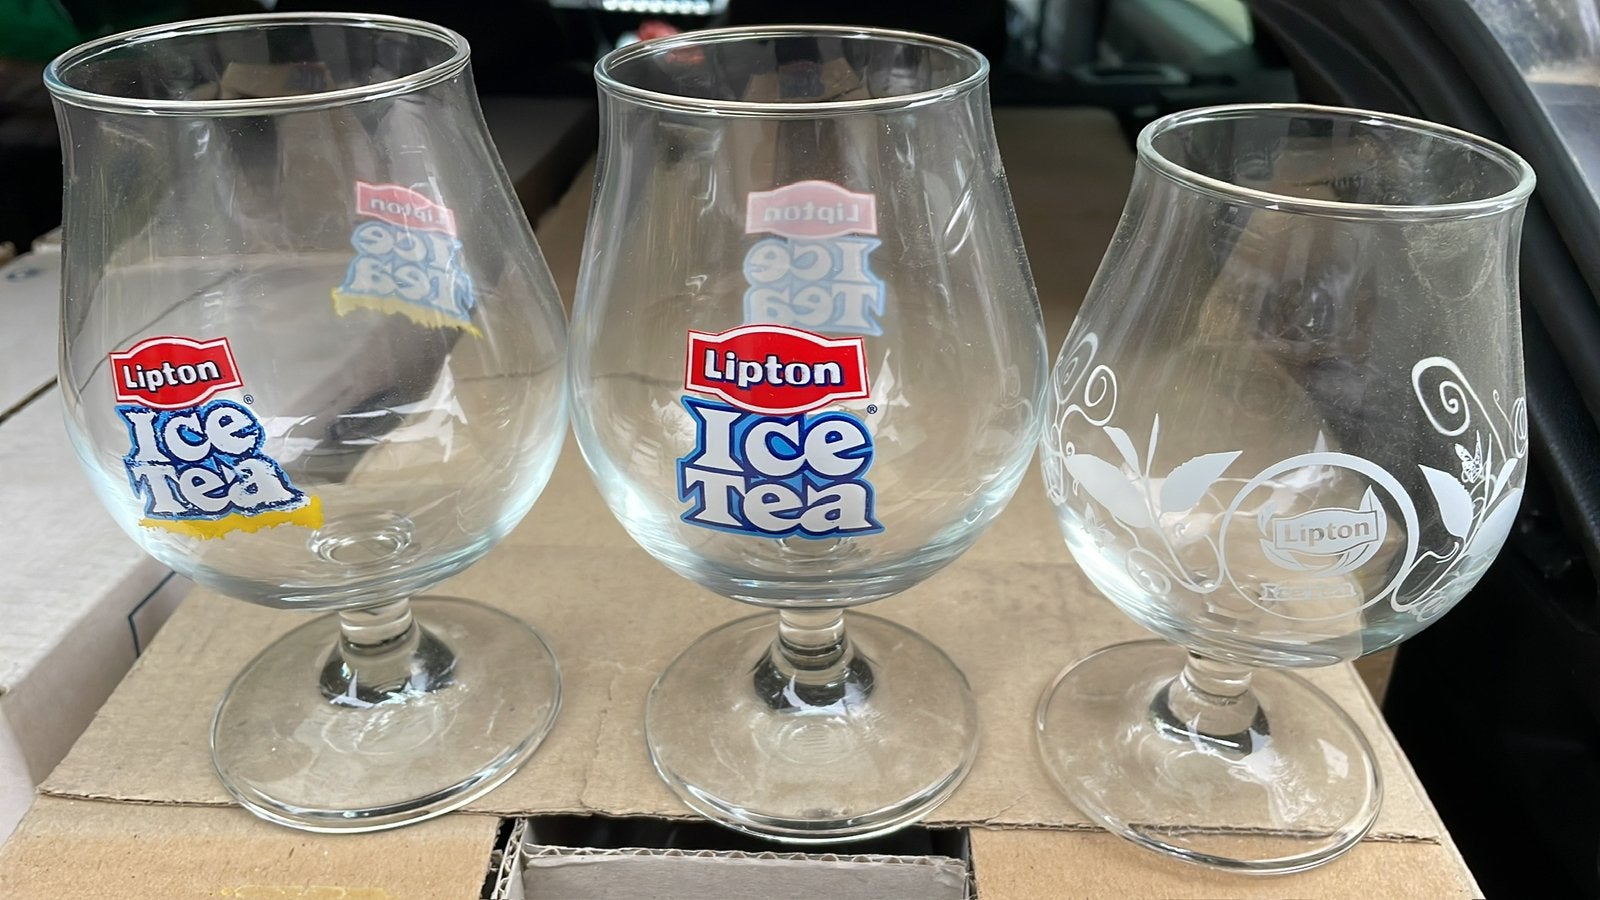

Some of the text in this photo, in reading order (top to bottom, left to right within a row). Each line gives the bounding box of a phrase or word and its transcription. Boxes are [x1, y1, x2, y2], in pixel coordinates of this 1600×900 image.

[121, 360, 221, 392] Lipton
[704, 348, 845, 389] Lipton
[123, 403, 261, 462] Ice
[690, 404, 868, 478] Ice
[130, 456, 306, 515] Tea
[683, 466, 875, 534] Tea
[1283, 521, 1370, 547] Lipton
